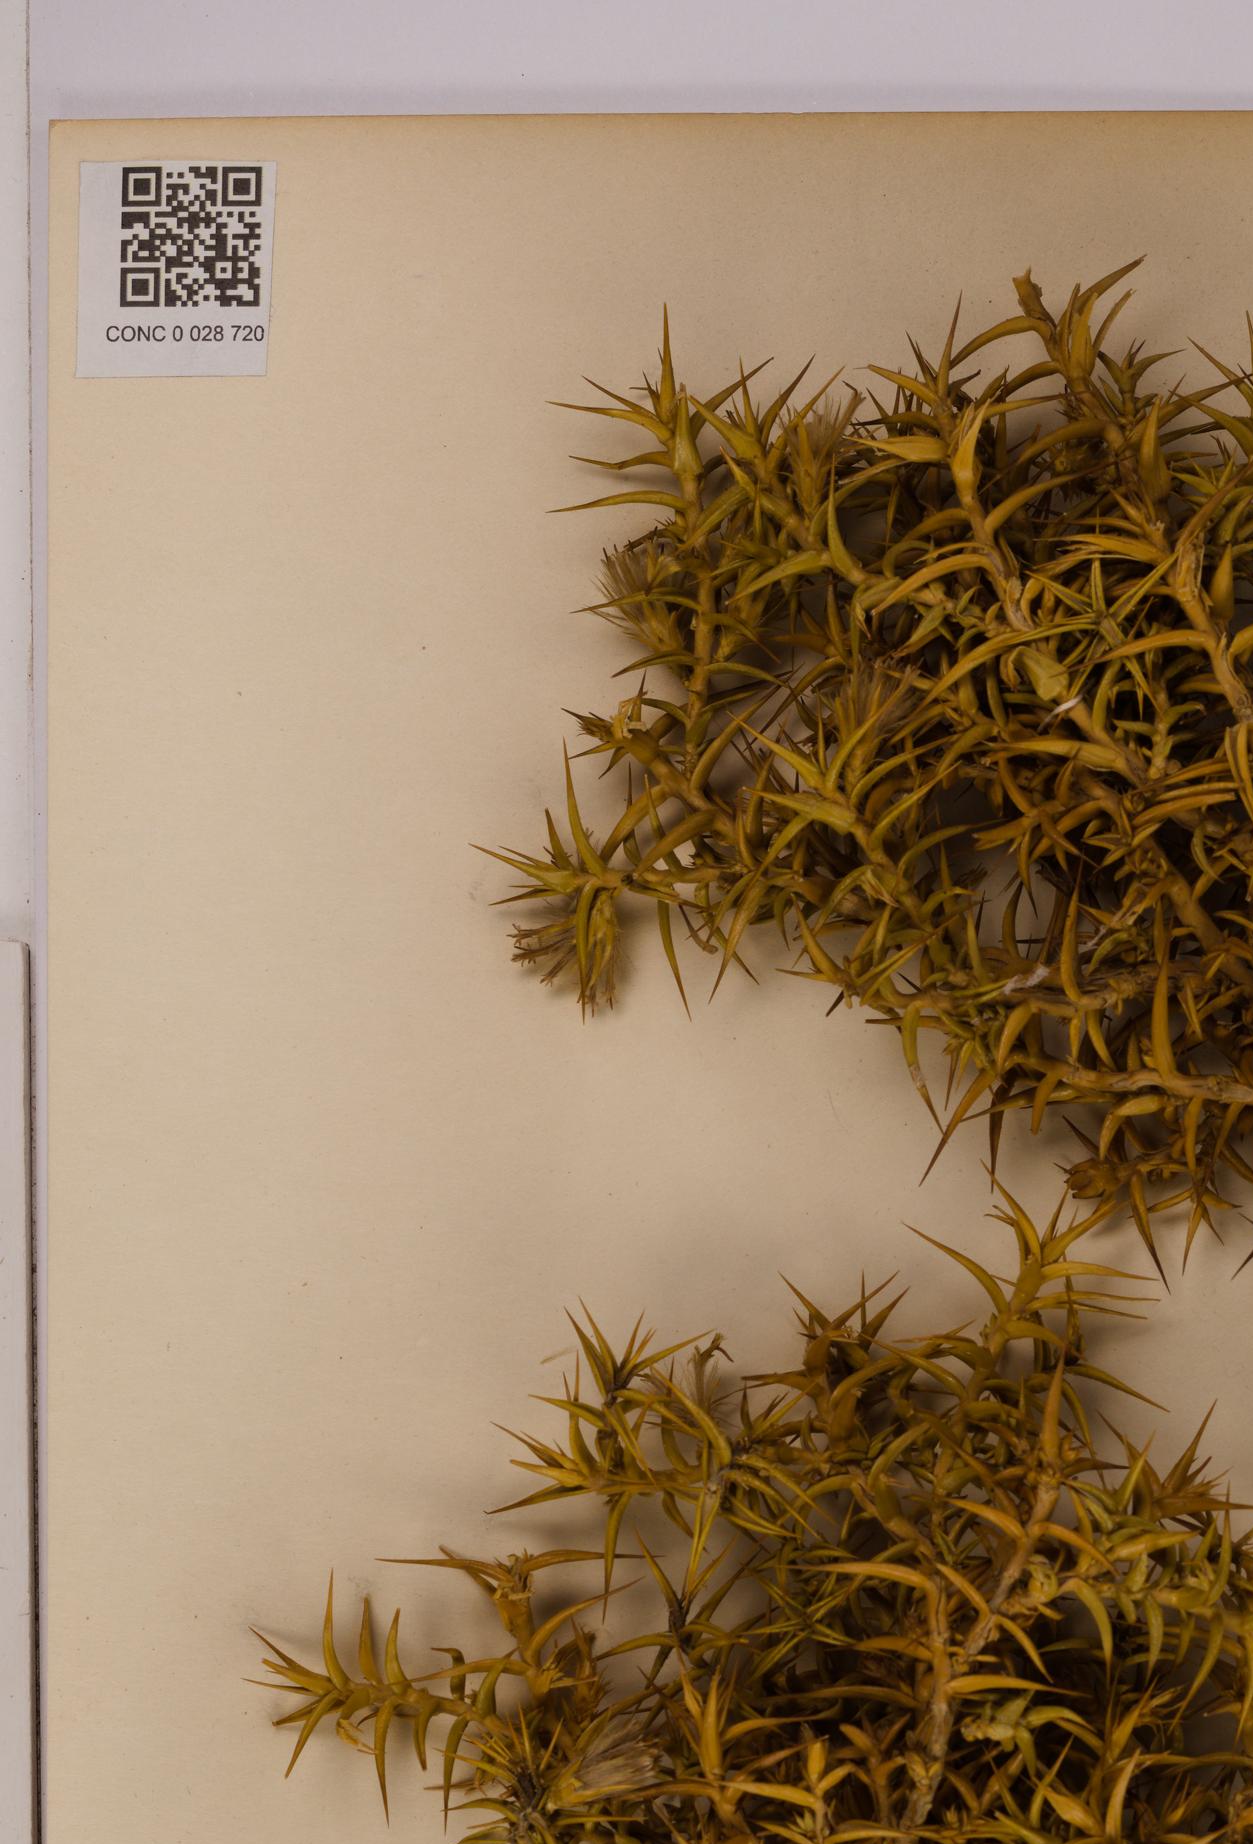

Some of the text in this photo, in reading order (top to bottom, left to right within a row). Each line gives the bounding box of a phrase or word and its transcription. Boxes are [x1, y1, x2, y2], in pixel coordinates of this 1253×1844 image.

[106, 325, 265, 342] CONC 0 028 720
